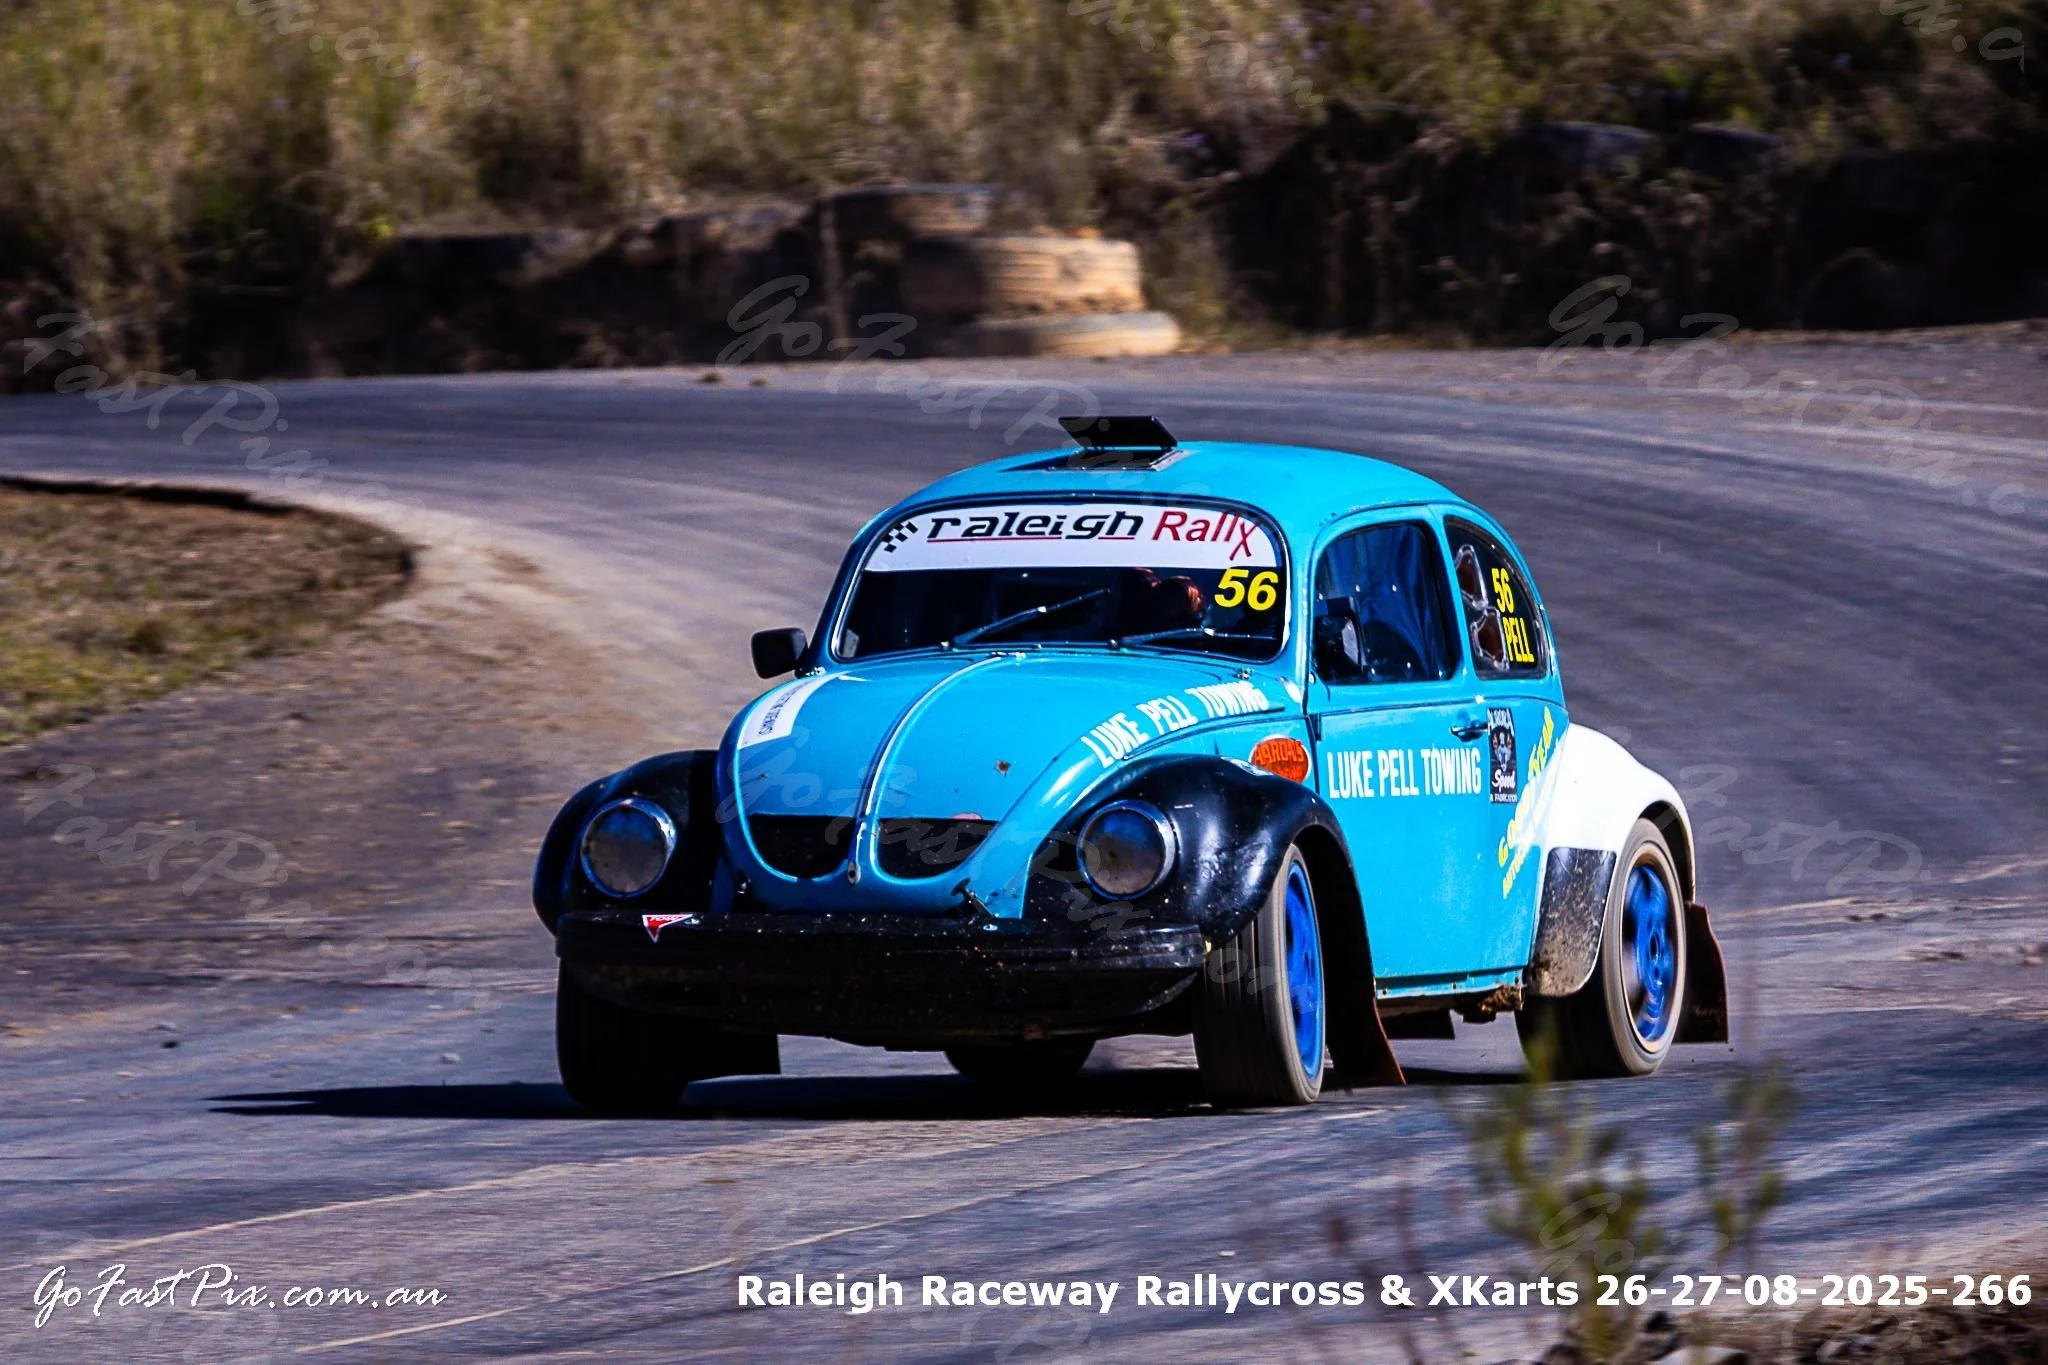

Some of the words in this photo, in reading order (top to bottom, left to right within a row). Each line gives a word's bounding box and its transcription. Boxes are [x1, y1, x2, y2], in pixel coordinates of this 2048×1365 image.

[927, 510, 1143, 541] raleigh
[1213, 567, 1279, 611] 56
[1491, 567, 1515, 614] 56
[1502, 616, 1535, 664] PELL
[1081, 711, 1151, 769] LUKE
[1136, 694, 1199, 735] PELL
[1184, 680, 1270, 719] TOWING
[1327, 751, 1375, 799] LUKE
[1377, 749, 1419, 797] PELL
[1419, 746, 1482, 796] TOWING
[1491, 768, 1517, 795] Speed
